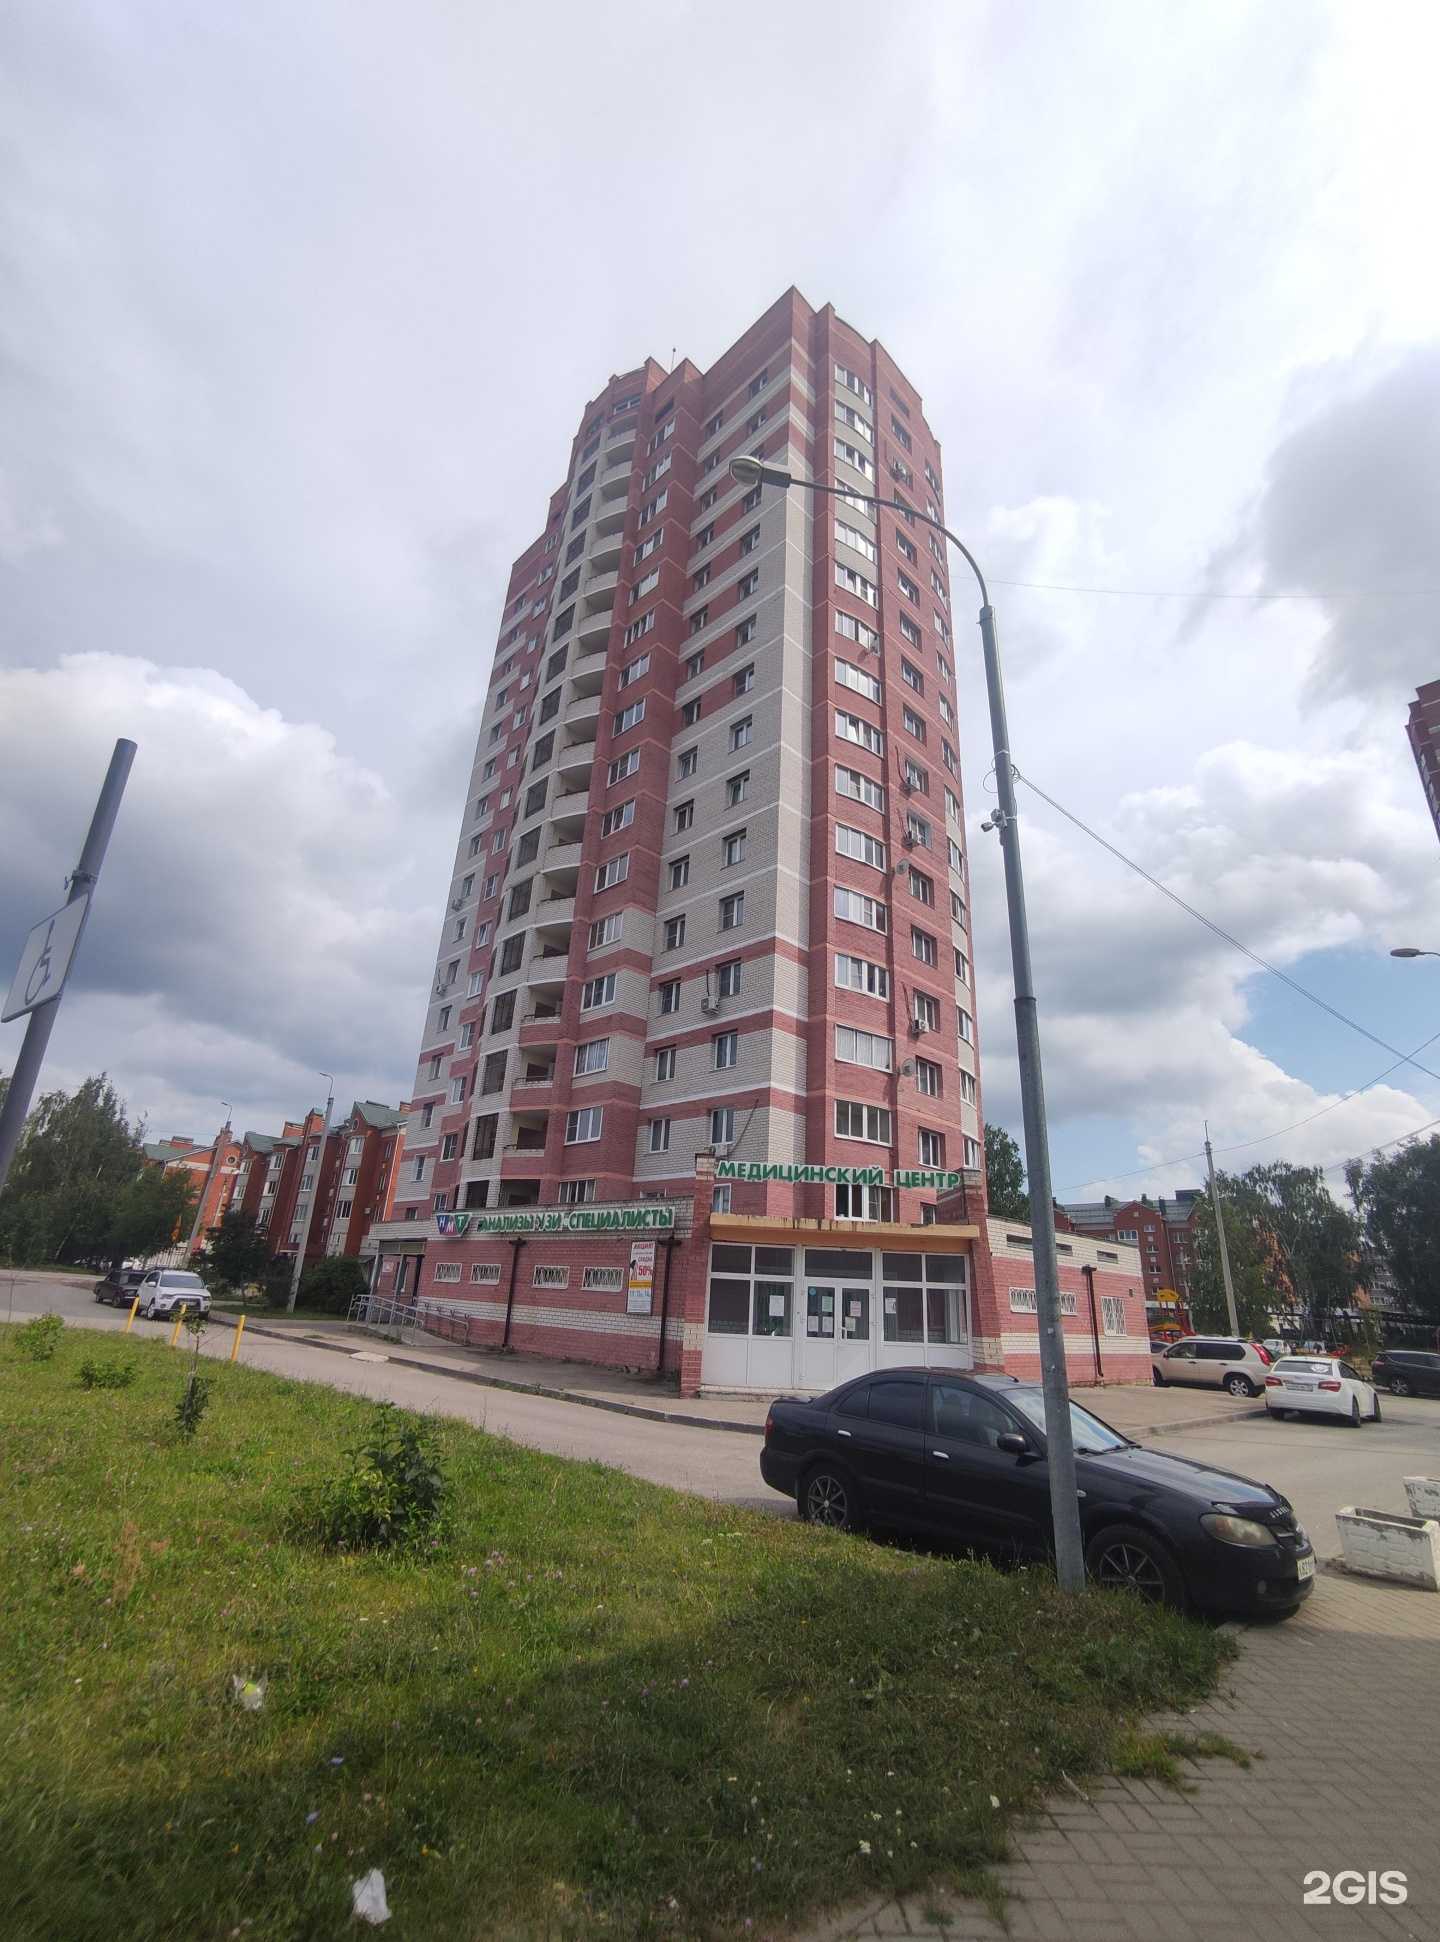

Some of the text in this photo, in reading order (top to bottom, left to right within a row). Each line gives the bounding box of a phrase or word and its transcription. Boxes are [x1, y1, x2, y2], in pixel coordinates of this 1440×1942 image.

[718, 1161, 959, 1188] МЕДИЦИНСКИЙ ЦЕНТР
[479, 1208, 674, 1232] АНАЛИЗЫ УЗИ СПЕЦИАЛИСТЫ
